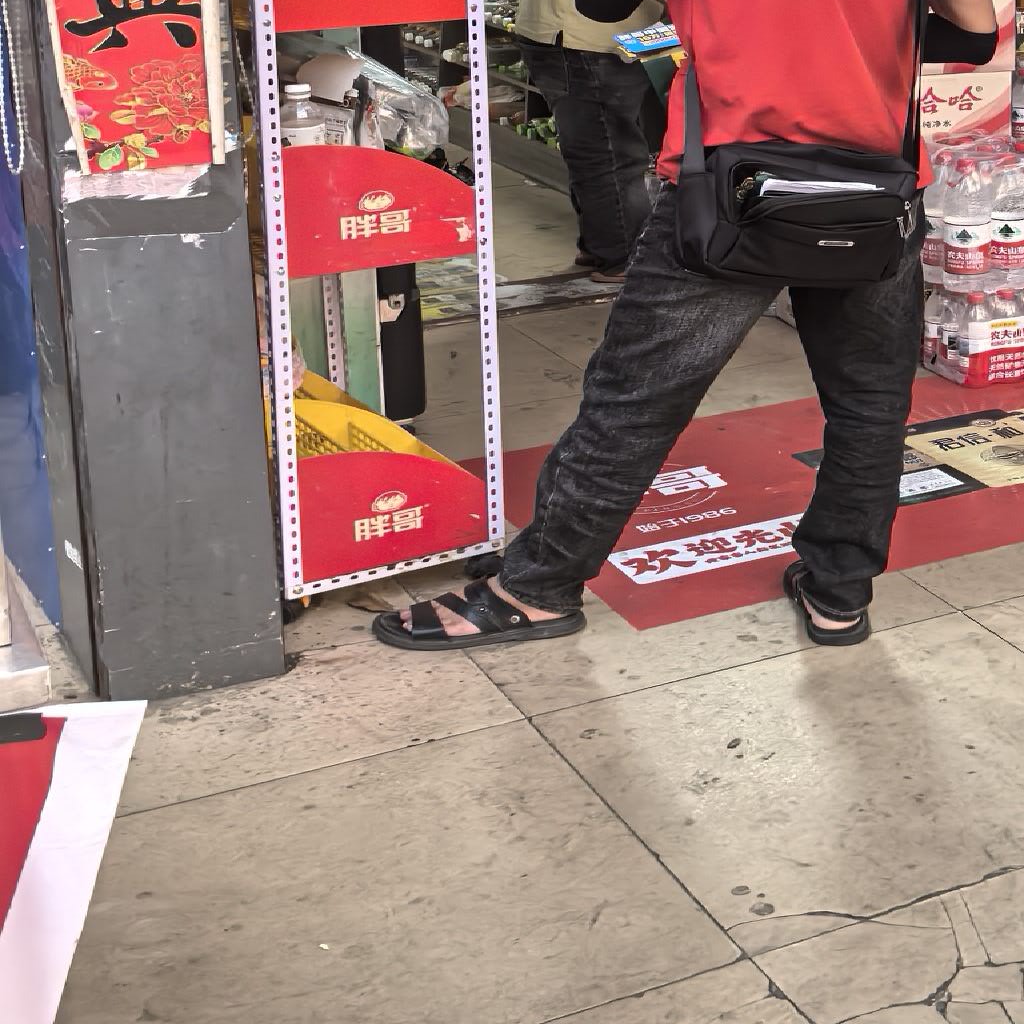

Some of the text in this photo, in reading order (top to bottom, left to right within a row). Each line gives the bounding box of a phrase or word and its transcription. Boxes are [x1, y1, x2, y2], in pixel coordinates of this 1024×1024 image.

[339, 208, 413, 242] 胖哥
[646, 465, 729, 496] 哥
[352, 506, 424, 543] 胖哥
